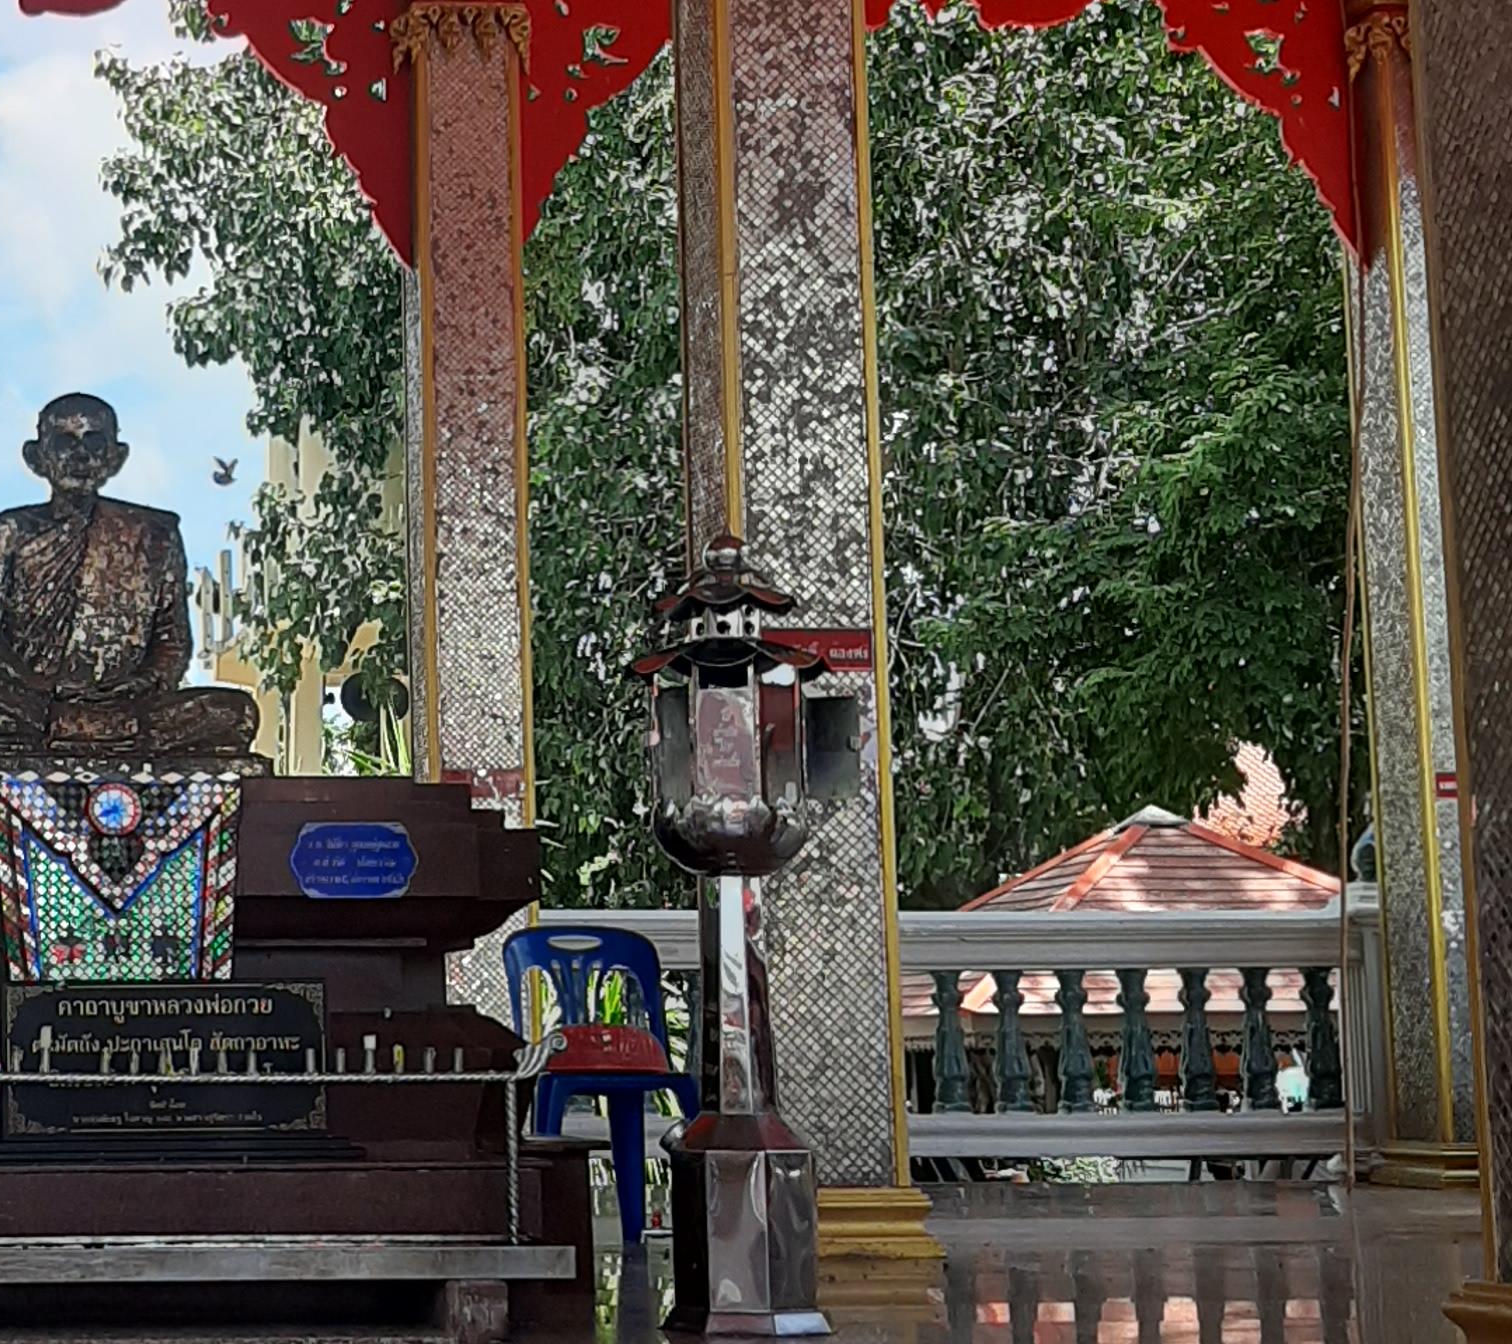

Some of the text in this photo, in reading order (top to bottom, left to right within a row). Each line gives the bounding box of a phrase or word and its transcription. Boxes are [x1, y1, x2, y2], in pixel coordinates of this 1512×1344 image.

[58, 993, 273, 1024] คาถาบูชาหลวงพ่อกวย
